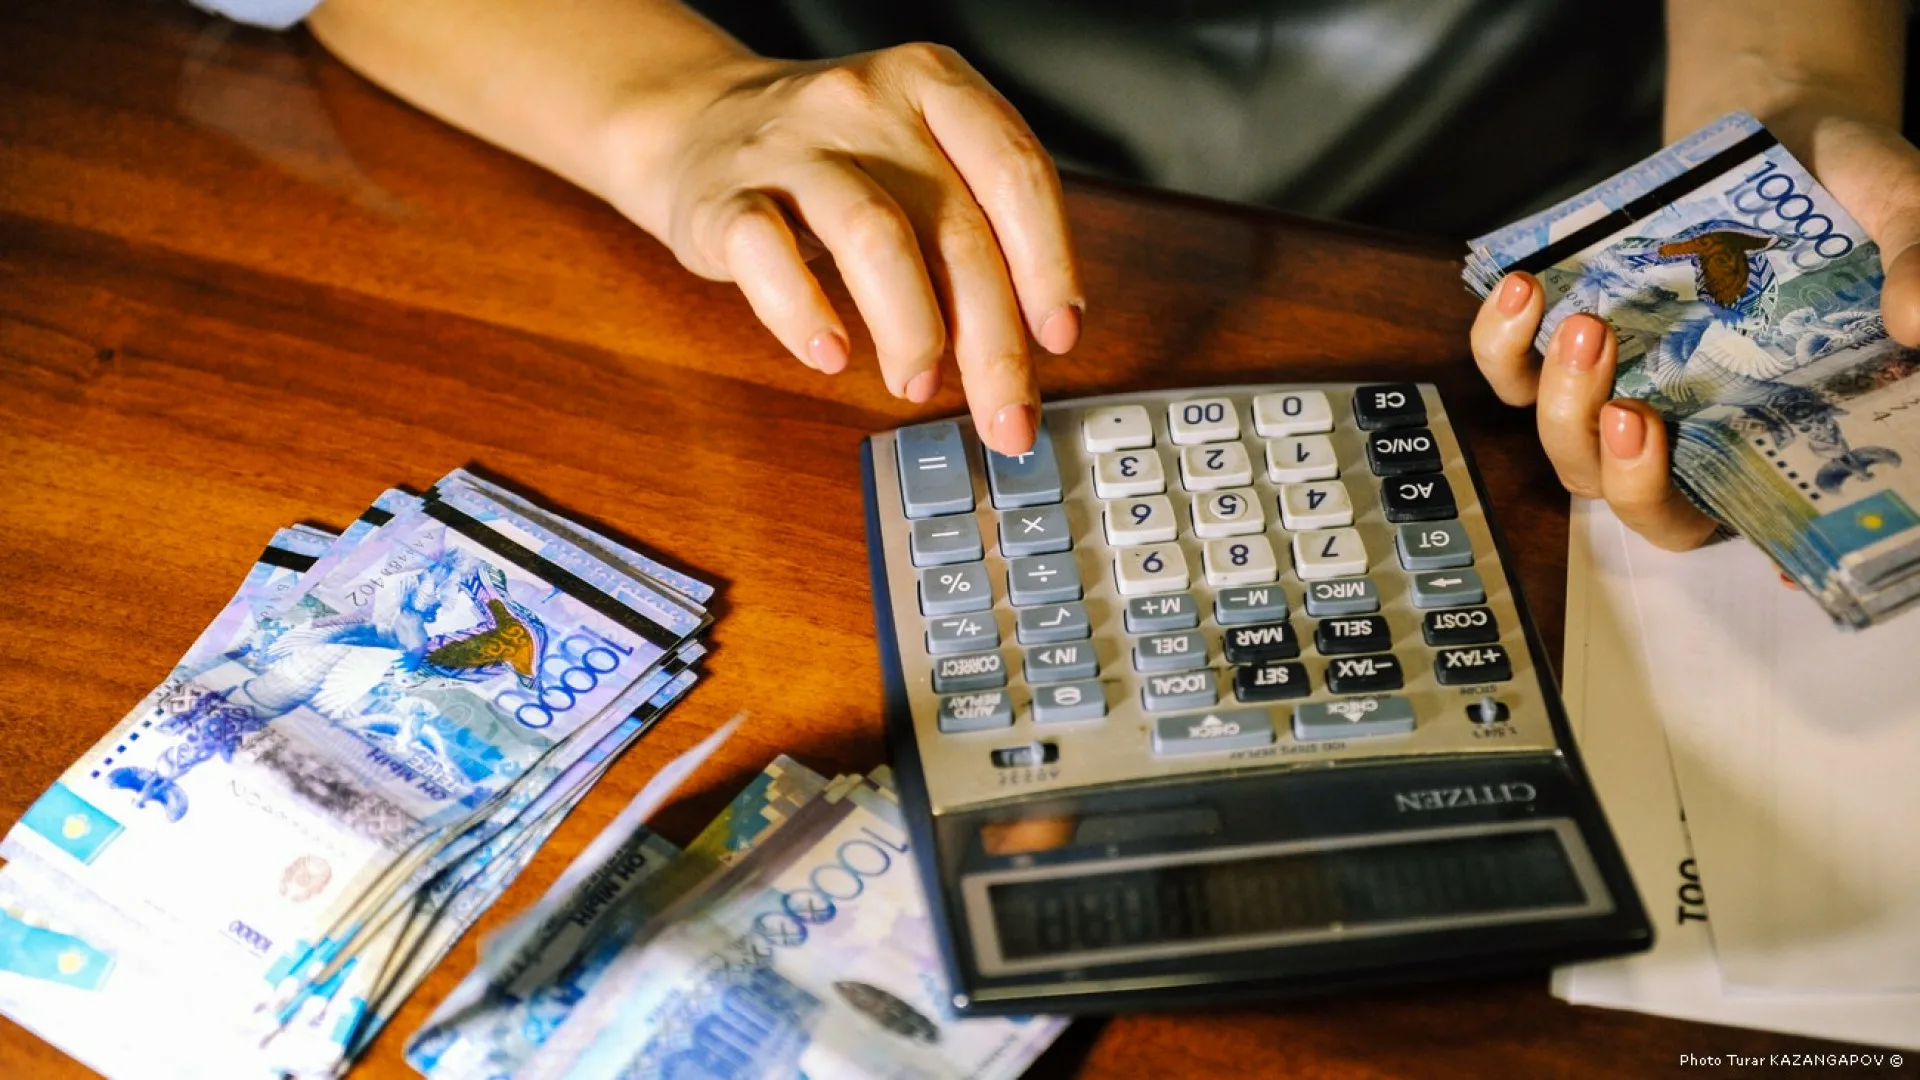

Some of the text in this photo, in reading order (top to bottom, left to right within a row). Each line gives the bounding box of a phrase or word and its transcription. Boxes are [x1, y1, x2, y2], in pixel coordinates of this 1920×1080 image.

[1744, 160, 1853, 259] 10000
[1282, 396, 1302, 416] 0
[1375, 392, 1406, 409] CE
[1183, 403, 1224, 425] 00
[1296, 442, 1311, 463] 1
[1376, 436, 1430, 454] ON/C
[1120, 457, 1138, 478] 3
[1206, 450, 1225, 471] 2
[1306, 489, 1327, 510] 4
[1399, 482, 1433, 499] AC
[1130, 504, 1152, 526] 6
[1218, 495, 1237, 516] 5
[1321, 535, 1339, 558] 7
[1419, 531, 1450, 548] GT
[1143, 552, 1164, 573] 9
[1229, 545, 1249, 566] 8
[1316, 581, 1365, 598] MRC
[1140, 598, 1180, 614] M+
[1330, 621, 1372, 637] SELL
[1434, 611, 1488, 629] COST
[1152, 636, 1188, 654] DEL
[1236, 627, 1283, 646] MAR
[941, 655, 1000, 677] CORRECT
[1445, 649, 1500, 668] +TAX
[514, 641, 635, 730] 10000
[1152, 675, 1206, 695] LOCAL
[1254, 667, 1288, 685] SET
[949, 692, 1001, 708] REPLAY
[1327, 700, 1378, 715] CHECK
[954, 705, 995, 719] AUTO
[1189, 722, 1240, 739] CHECK
[1394, 783, 1537, 812] CITIZEN
